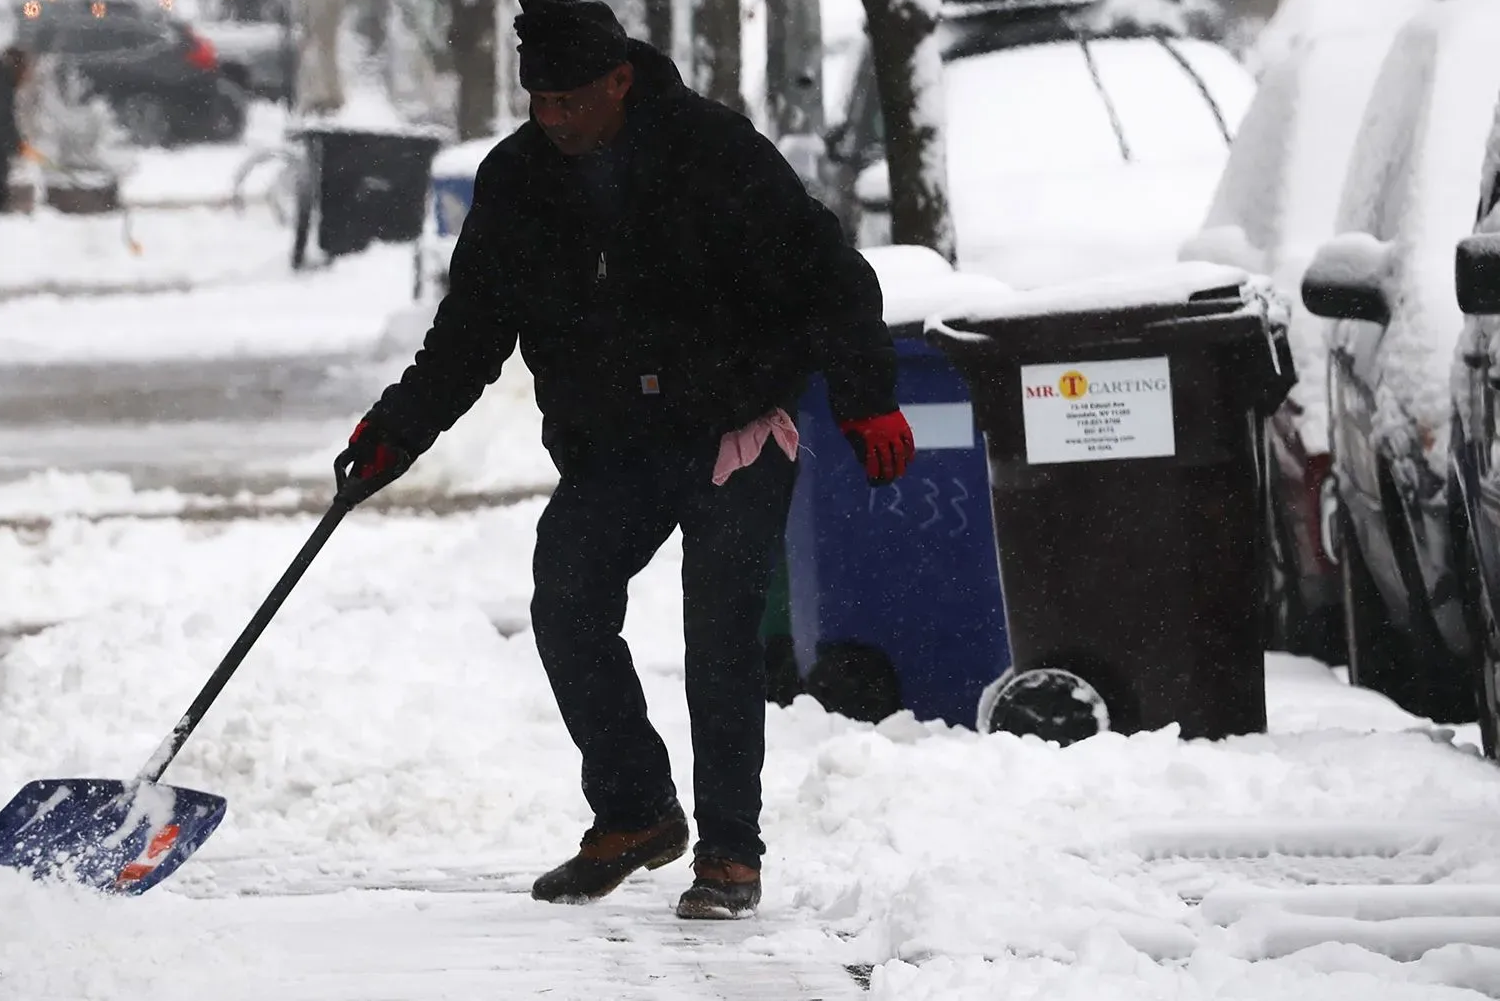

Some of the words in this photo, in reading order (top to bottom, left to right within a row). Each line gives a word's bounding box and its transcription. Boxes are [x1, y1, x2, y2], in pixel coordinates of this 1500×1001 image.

[1026, 385, 1059, 399] MR.
[1062, 375, 1084, 396] T
[1089, 378, 1166, 395] CARTING
